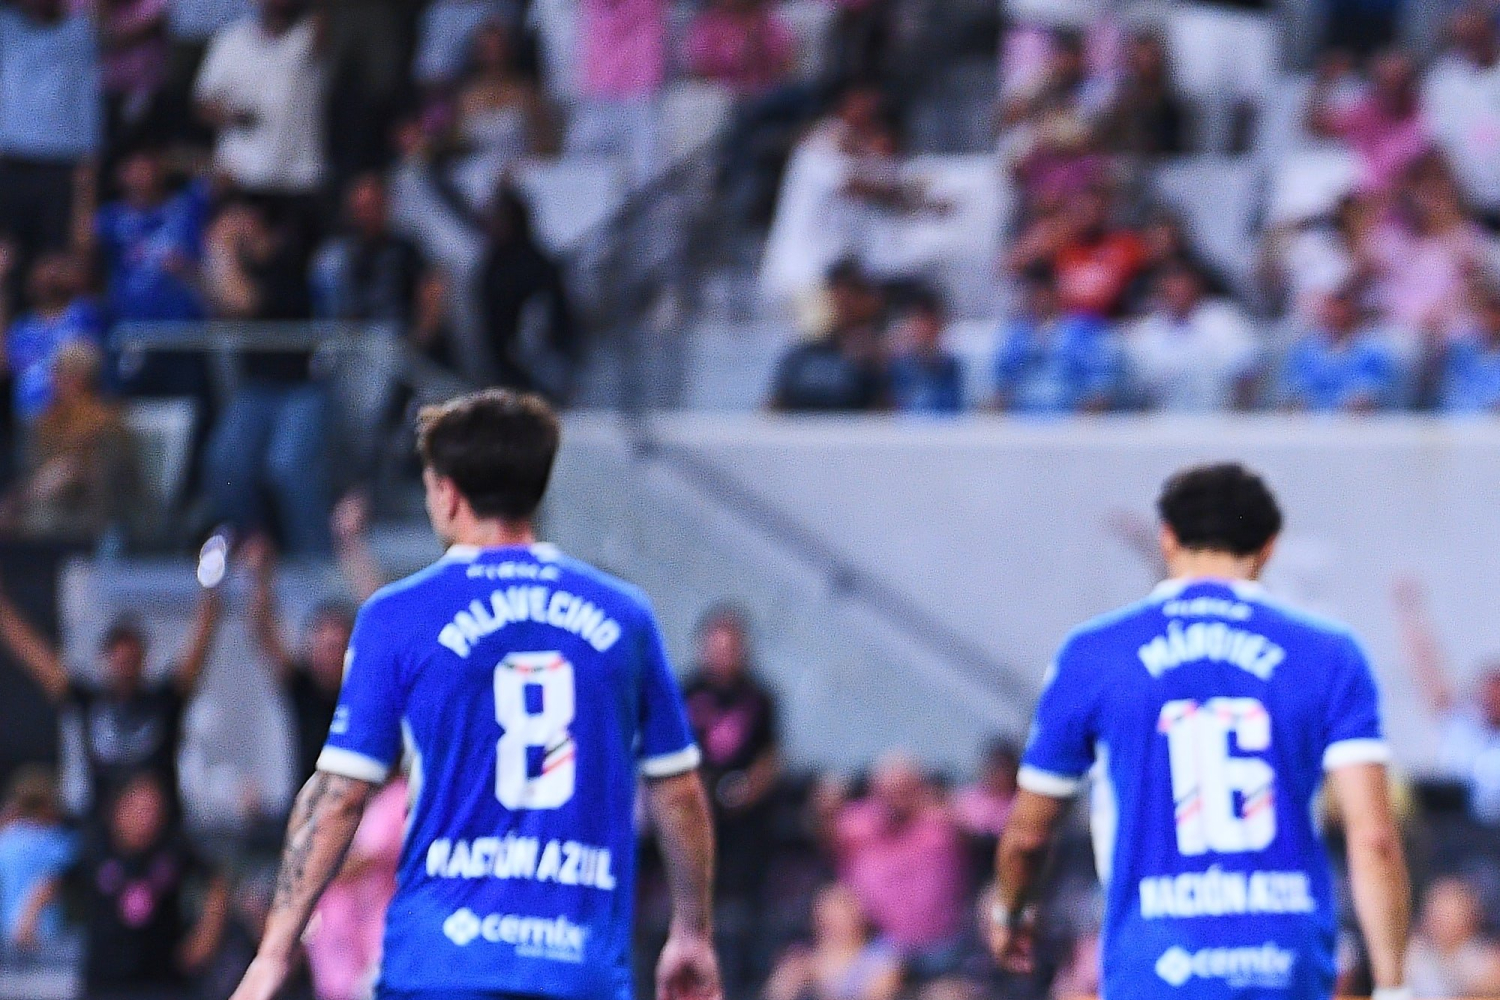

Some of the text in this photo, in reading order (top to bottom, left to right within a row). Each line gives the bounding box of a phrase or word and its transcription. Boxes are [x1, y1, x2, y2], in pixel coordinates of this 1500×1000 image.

[437, 585, 622, 660] PALAVECINO
[493, 651, 577, 811] 8
[1158, 696, 1277, 857] 16
